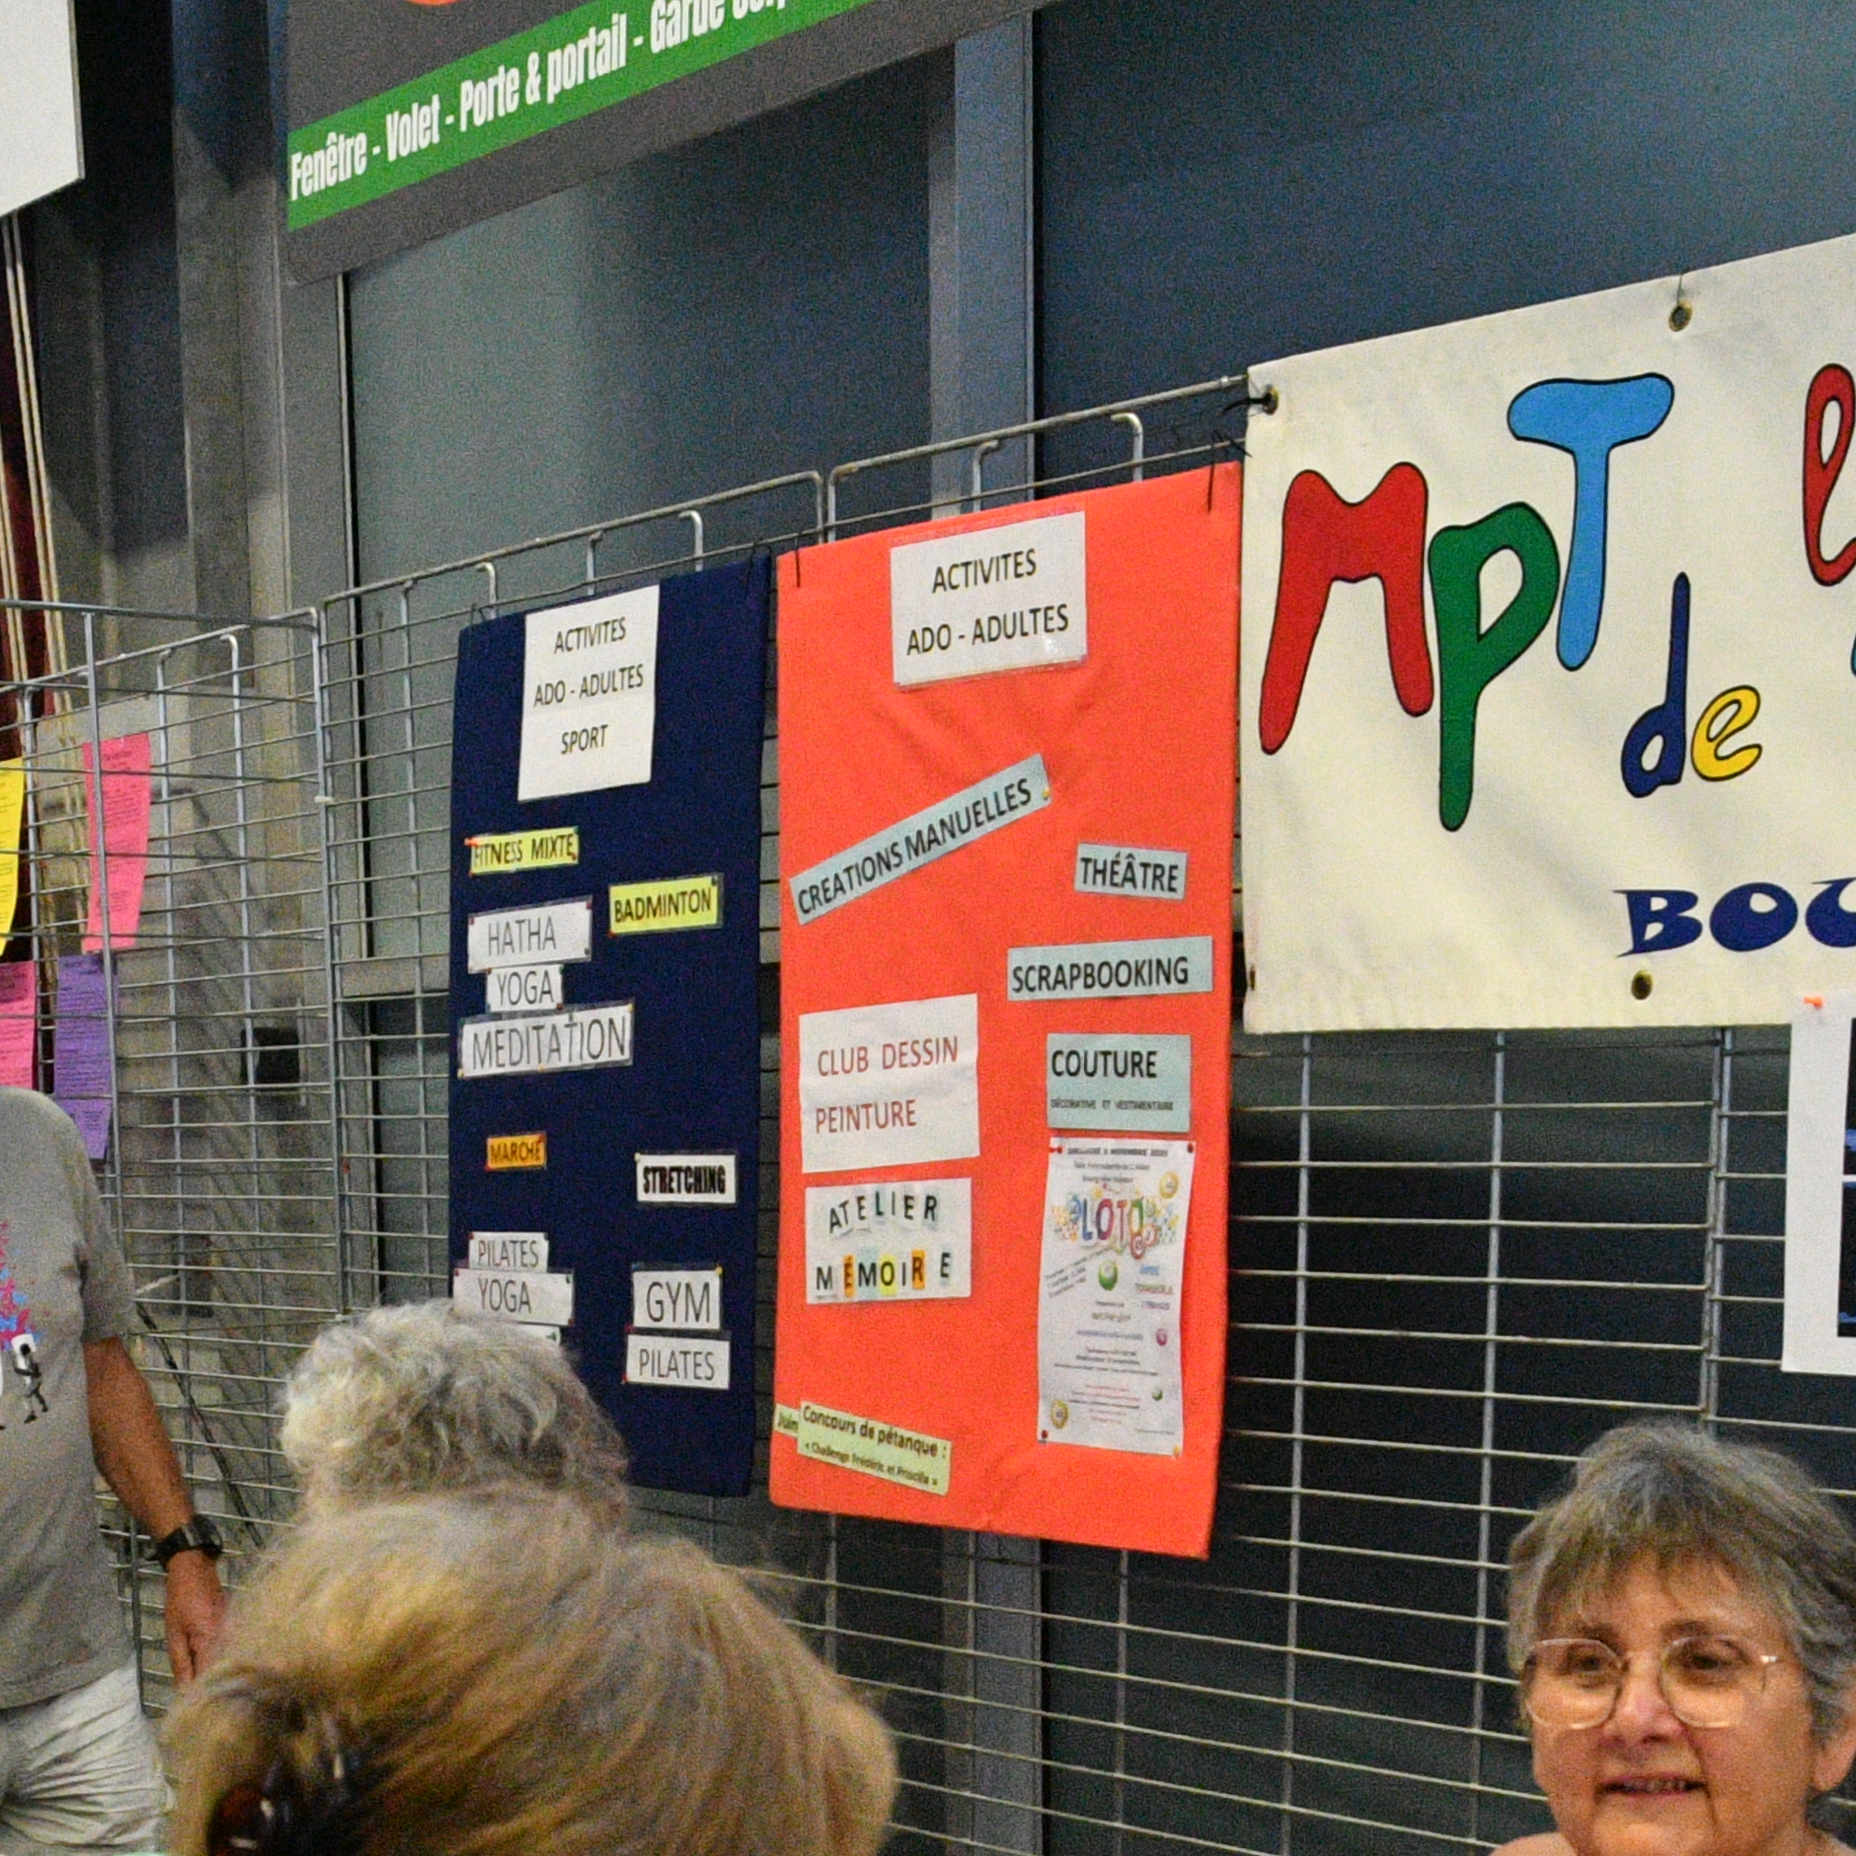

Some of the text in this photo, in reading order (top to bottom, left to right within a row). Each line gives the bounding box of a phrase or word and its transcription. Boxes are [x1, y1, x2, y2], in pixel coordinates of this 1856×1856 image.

[291, 132, 367, 200] Fenêtre
[386, 94, 440, 162] Volet
[460, 65, 520, 132] Porte
[525, 52, 540, 104] &
[547, 13, 627, 103] portail
[931, 548, 1038, 594] ACTIVITES
[554, 616, 627, 655] ACTIVITES
[907, 622, 952, 656] ADO
[971, 603, 1070, 646] ADULTES
[534, 684, 566, 708] ADO
[579, 664, 644, 700] ADULTES
[1621, 571, 1764, 799] de
[561, 724, 608, 755] SPORT
[531, 833, 574, 860] MIXTE
[798, 777, 1032, 915] CREATIONS MANUELLES
[1079, 850, 1179, 894] THÉÂTRE
[614, 888, 712, 923] BADMINTON
[488, 915, 557, 957] HATHA
[496, 970, 554, 1006] YOGA
[1012, 955, 1190, 994] SCRAPBOOKING
[472, 1016, 626, 1070] MEDITATION
[817, 1035, 959, 1077] CLUB DESSIN
[1051, 1049, 1158, 1079] COUTURE
[815, 1099, 917, 1135] PEINTURE
[489, 1138, 542, 1163] MARCHE
[643, 1165, 726, 1195] STRETCHING
[828, 1194, 938, 1235] ATELIER
[1082, 1197, 1144, 1241] LOTO
[477, 1239, 539, 1268] PILATES
[477, 1278, 532, 1314] YOGA
[646, 1281, 711, 1323] GYM
[638, 1348, 715, 1381] PILATES
[803, 1405, 856, 1435] Concours
[859, 1421, 875, 1440] de
[878, 1426, 938, 1458] pétanque
